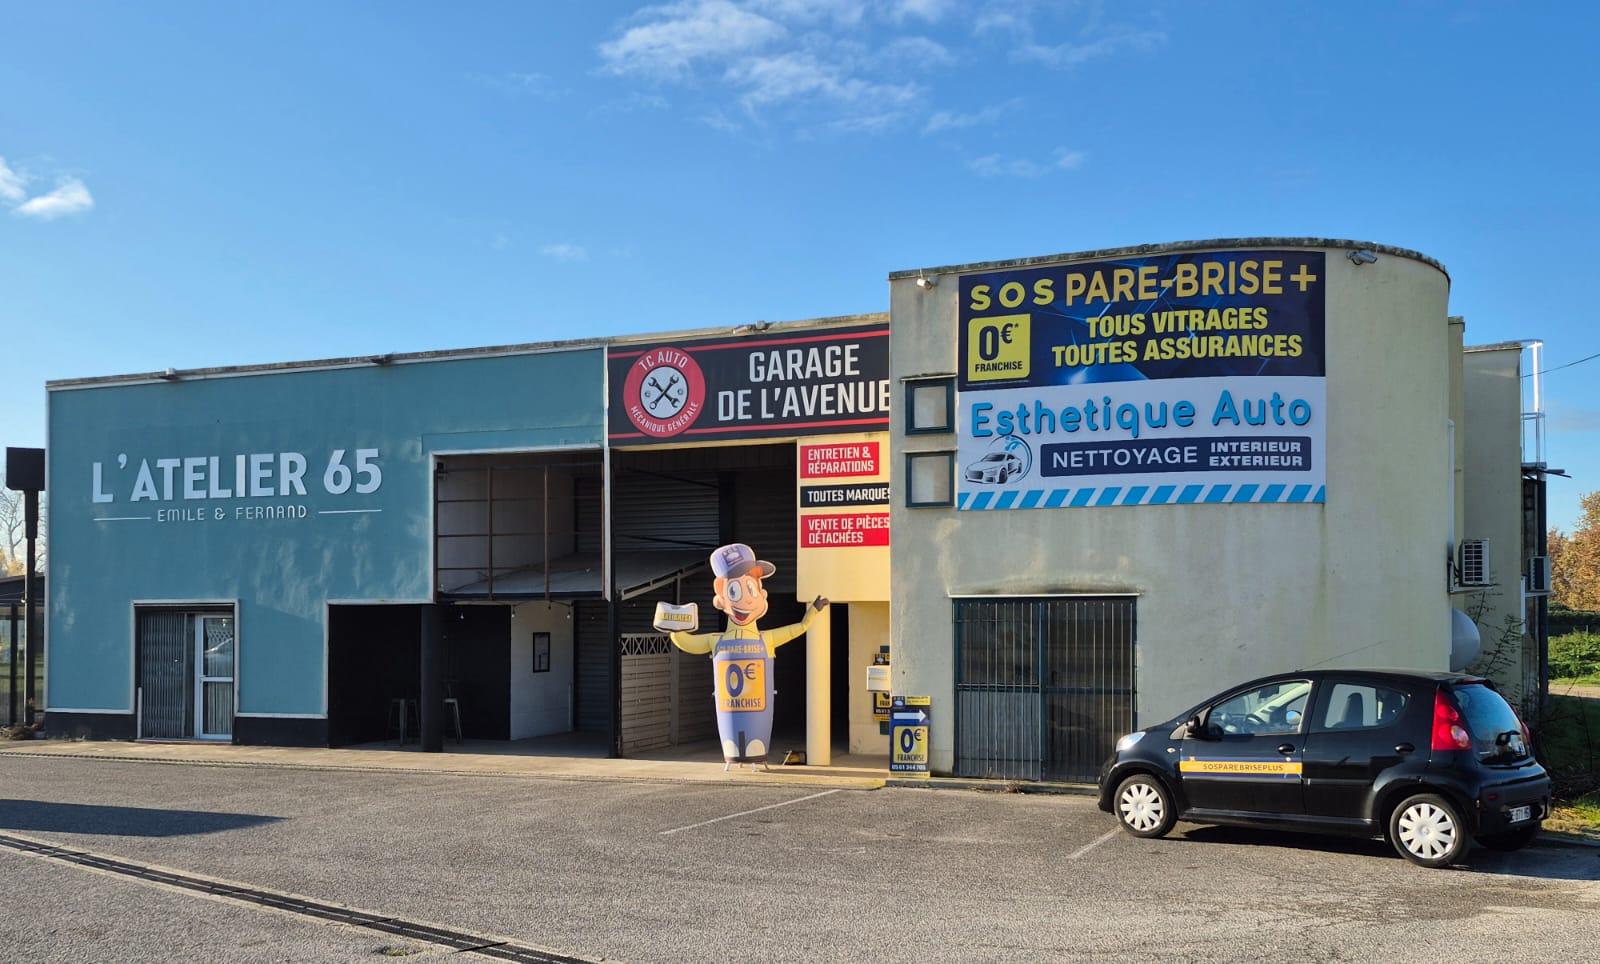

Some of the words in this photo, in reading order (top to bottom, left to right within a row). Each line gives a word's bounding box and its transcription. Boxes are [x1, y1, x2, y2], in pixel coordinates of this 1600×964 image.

[1065, 260, 1283, 307] PARE-BRISE
[1086, 313, 1146, 338] TOUS
[1151, 307, 1268, 335] VITRAGES
[638, 355, 654, 371] TC
[658, 350, 689, 369] AUTO
[1051, 341, 1138, 368] TOUTES
[1143, 335, 1303, 361] ASSURANCES
[749, 344, 860, 382] GARAGE
[975, 360, 1023, 374] FRANCHISE
[718, 389, 752, 421] DE
[761, 380, 890, 419] L'AVENUE
[631, 404, 666, 433] MÉCANIQUE
[668, 401, 698, 432] GÉNÉRALE
[970, 396, 1196, 439] Esthetique
[1210, 389, 1312, 427] Auto
[808, 447, 860, 461] ENTRETIEN
[862, 446, 871, 459] &
[1052, 446, 1198, 469] NETTOYAGE
[1210, 441, 1302, 454] INTERIEUR
[808, 460, 874, 474] RÉPARATIONS
[1209, 455, 1302, 468] EXTERIEUR
[92, 452, 308, 504] L'ATELIER
[323, 448, 381, 495] 65
[808, 489, 844, 503] TOUTES
[157, 507, 205, 522] EMILE
[214, 507, 226, 520] &
[235, 505, 307, 520] FERNAND
[808, 518, 839, 531] VENTE
[841, 517, 854, 530] DE
[856, 514, 890, 529] PIÈCES
[808, 530, 864, 545] DÉTACHÉES
